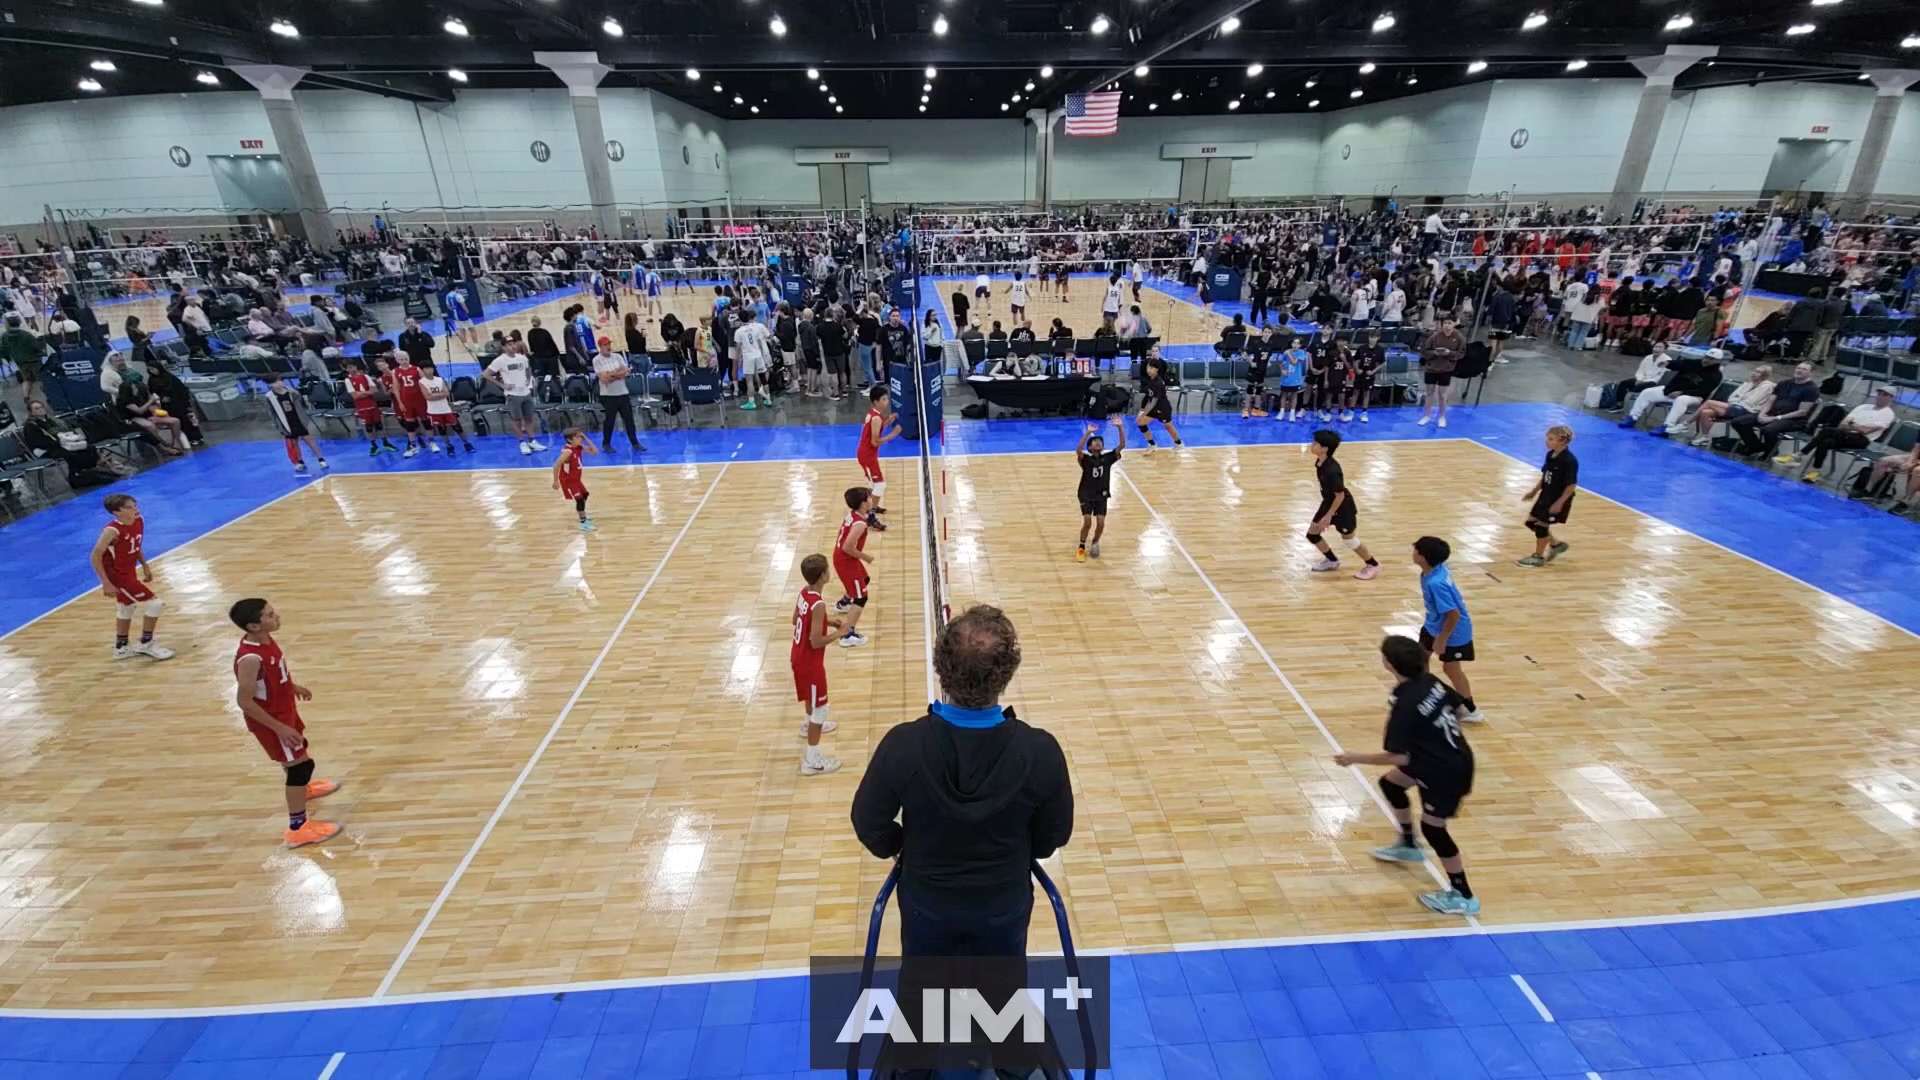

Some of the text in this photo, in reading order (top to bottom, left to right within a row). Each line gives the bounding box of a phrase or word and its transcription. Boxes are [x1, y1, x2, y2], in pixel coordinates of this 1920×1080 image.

[240, 139, 264, 149] EXIT
[1200, 228, 1209, 236] 25
[188, 244, 198, 253] 23
[465, 240, 476, 249] 24
[747, 333, 753, 344] 8
[1317, 349, 1326, 357] 34
[1059, 362, 1071, 374] 06
[1077, 361, 1089, 373] 06
[1334, 362, 1344, 370] 39
[402, 375, 414, 387] 15
